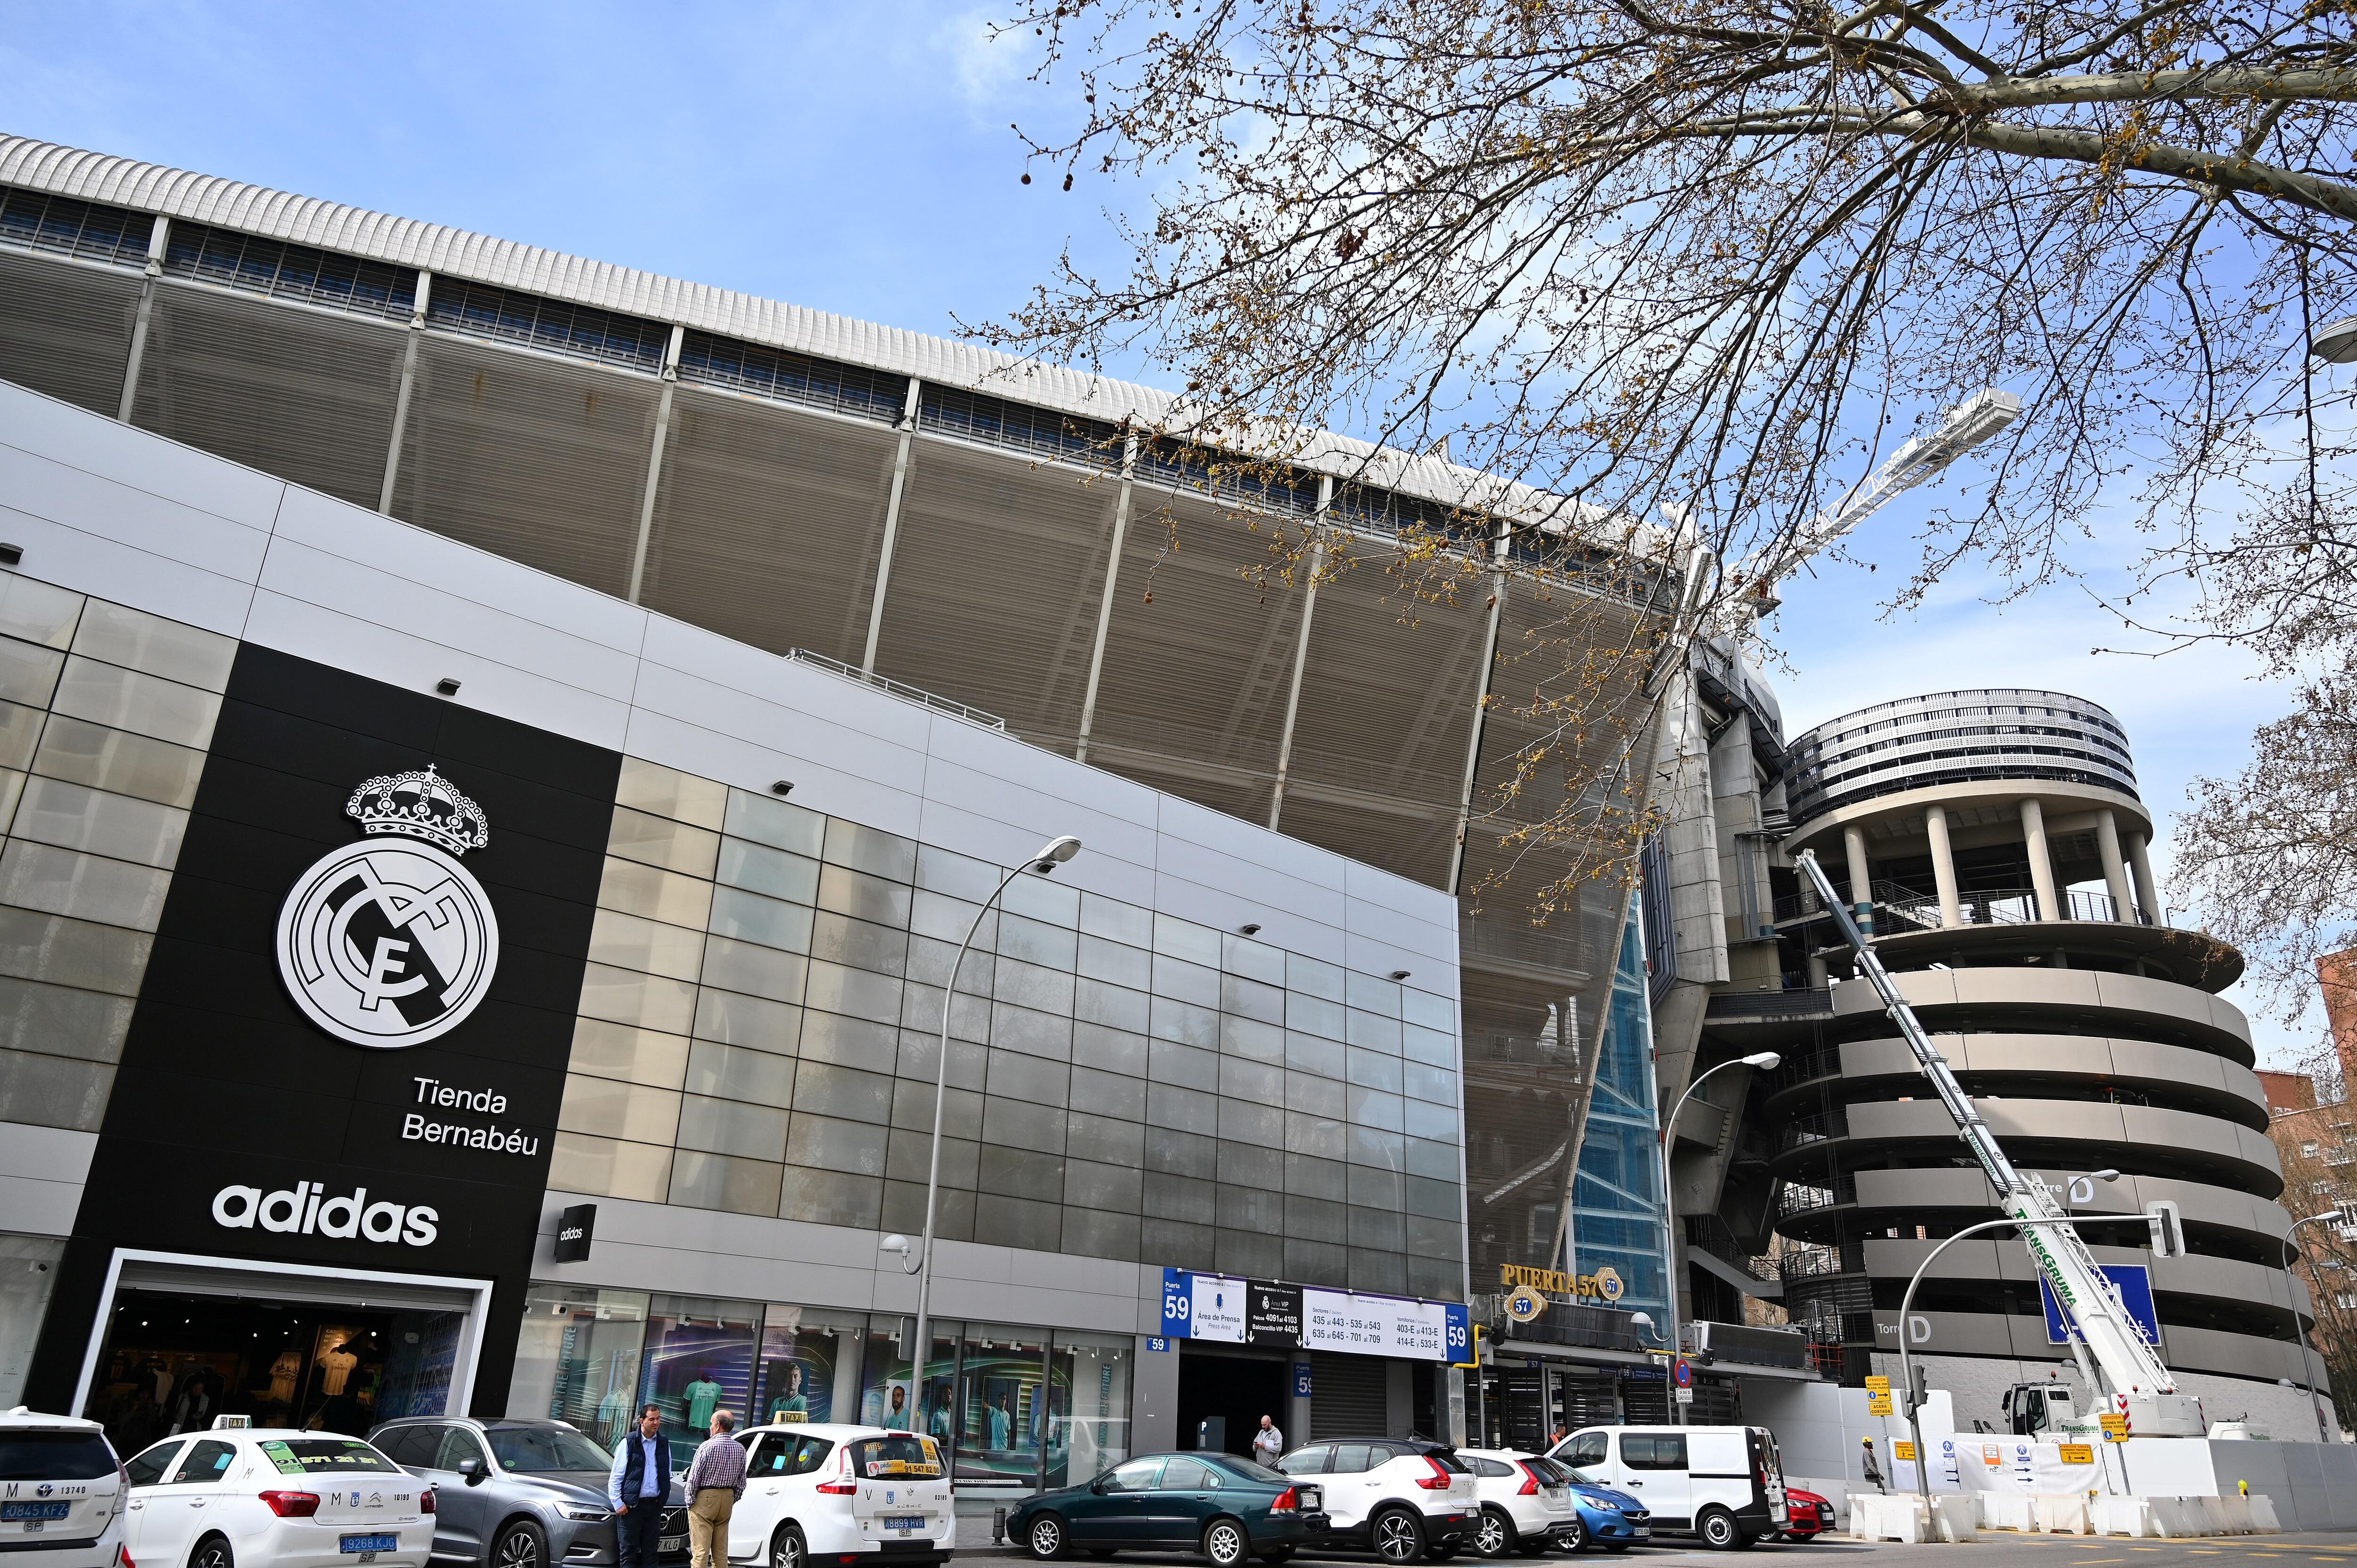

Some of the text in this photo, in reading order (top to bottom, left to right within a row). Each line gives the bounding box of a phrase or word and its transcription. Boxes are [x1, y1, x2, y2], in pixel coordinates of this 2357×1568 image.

[414, 1077, 507, 1114] Tienda
[1929, 1067, 1956, 1112] www.transgruma.com
[402, 1113, 538, 1156] Bernabéu
[2044, 1176, 2093, 1203] rre D
[212, 1181, 439, 1247] adidas
[560, 1227, 583, 1241] adidas
[1500, 1263, 1597, 1297] PUERTA 57
[1607, 1280, 1615, 1292] 57
[1165, 1295, 1189, 1320] 59
[1271, 1299, 1281, 1307] Área
[1515, 1300, 1528, 1312] 57
[1198, 1310, 1211, 1320] Área
[1221, 1314, 1240, 1323] Prensa
[1265, 1314, 1279, 1322] 4091
[1283, 1316, 1297, 1324] 4103
[1312, 1315, 1325, 1325] 435
[1332, 1317, 1344, 1327] 443
[1350, 1319, 1362, 1329] 535
[1368, 1321, 1381, 1330] 543
[1252, 1323, 1276, 1332] Balconcillo
[1284, 1325, 1298, 1334] 4435
[1396, 1324, 1415, 1334] 403-E
[1421, 1327, 1438, 1336] 413-E
[1908, 1316, 1931, 1343] D
[1312, 1329, 1325, 1338] 635
[1332, 1331, 1344, 1340] 645
[1350, 1332, 1361, 1342] 701
[1368, 1334, 1381, 1344] 709
[1448, 1326, 1466, 1347] 59
[1152, 1338, 1164, 1350] 59
[1397, 1337, 1415, 1347] 414-E
[1420, 1339, 1438, 1349] 533-E
[553, 1325, 577, 1396] THE FUTURE
[1623, 1369, 1630, 1377] 55
[1101, 1363, 1112, 1399] FUTURE
[229, 1418, 245, 1428] TAXI
[786, 1413, 801, 1422] TAXI
[1202, 1421, 1207, 1431] P
[6, 1483, 18, 1498] M
[61, 1486, 86, 1494] 13740
[865, 1489, 873, 1501] V
[330, 1492, 341, 1506] M
[8, 1503, 67, 1517] 0845 KFZ
[26, 1522, 42, 1531] SP
[889, 1519, 924, 1528] 8899 HVR
[348, 1537, 394, 1549] 9268 KJG
[663, 1540, 678, 1551] KLG
[360, 1554, 376, 1562] SP
